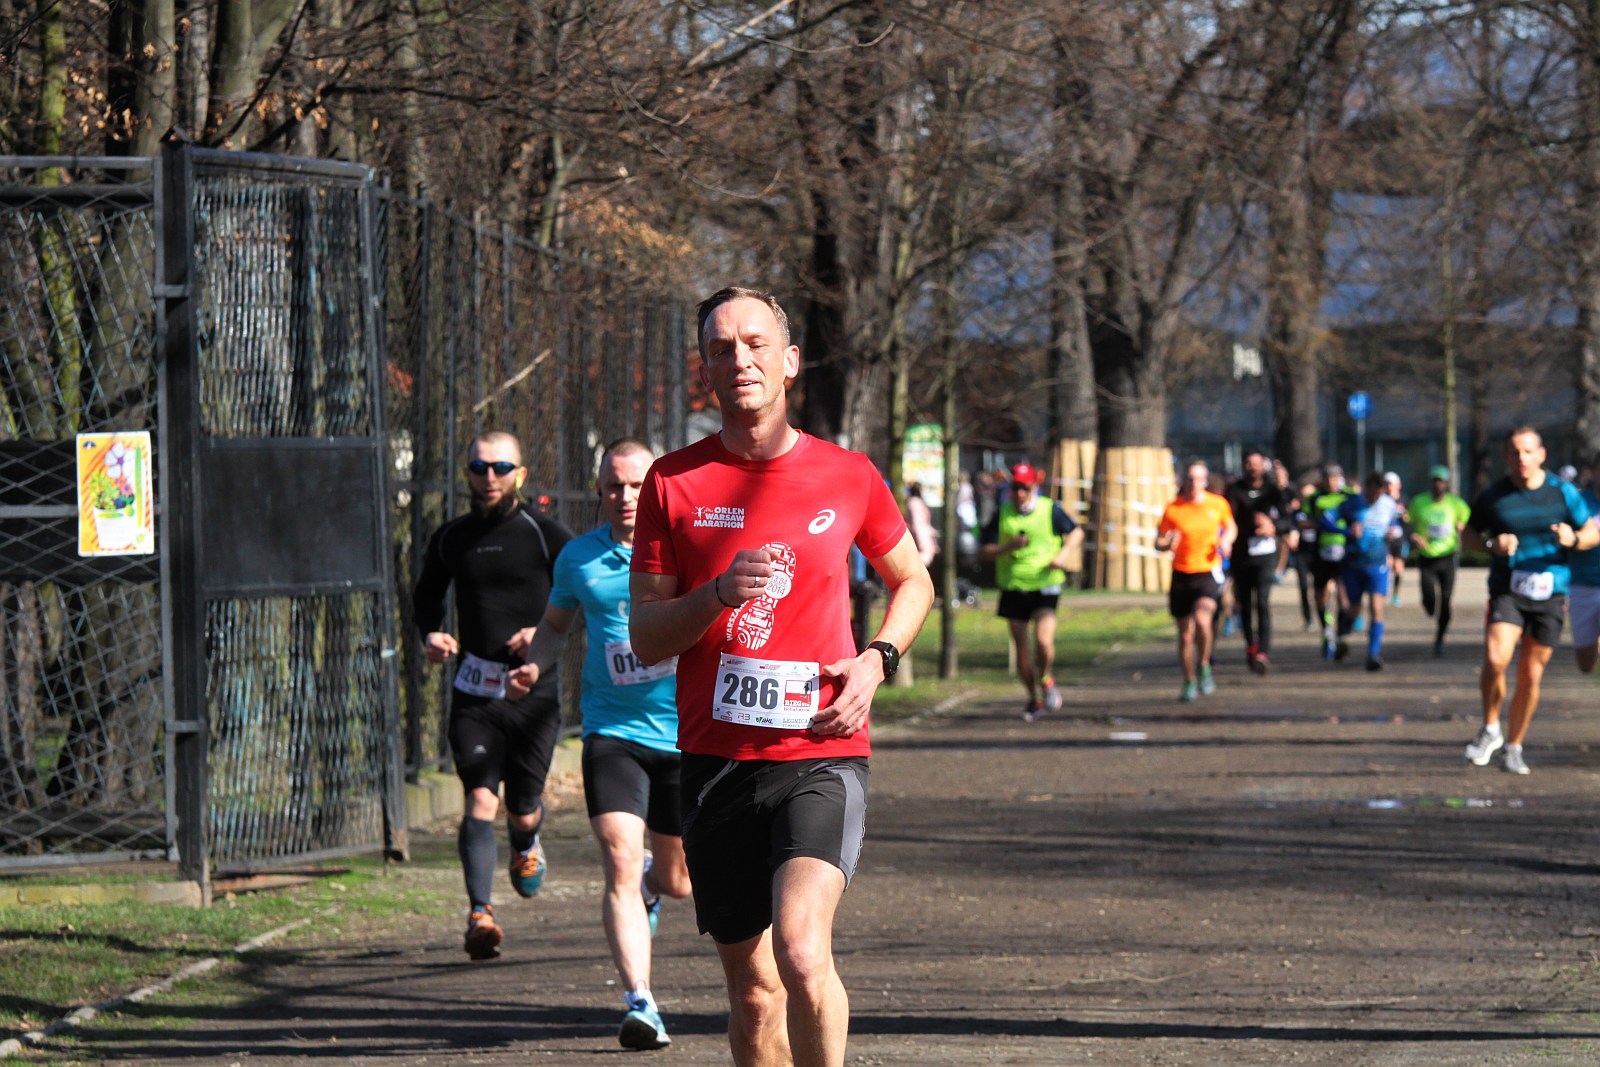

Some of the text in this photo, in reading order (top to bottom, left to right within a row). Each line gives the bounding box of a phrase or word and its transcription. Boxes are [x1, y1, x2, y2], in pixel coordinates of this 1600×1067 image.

[714, 506, 744, 515] ORLEN
[705, 513, 744, 521] WARSAW
[694, 519, 744, 528] MARATHON
[766, 582, 786, 596] 2014
[722, 673, 779, 709] 286
